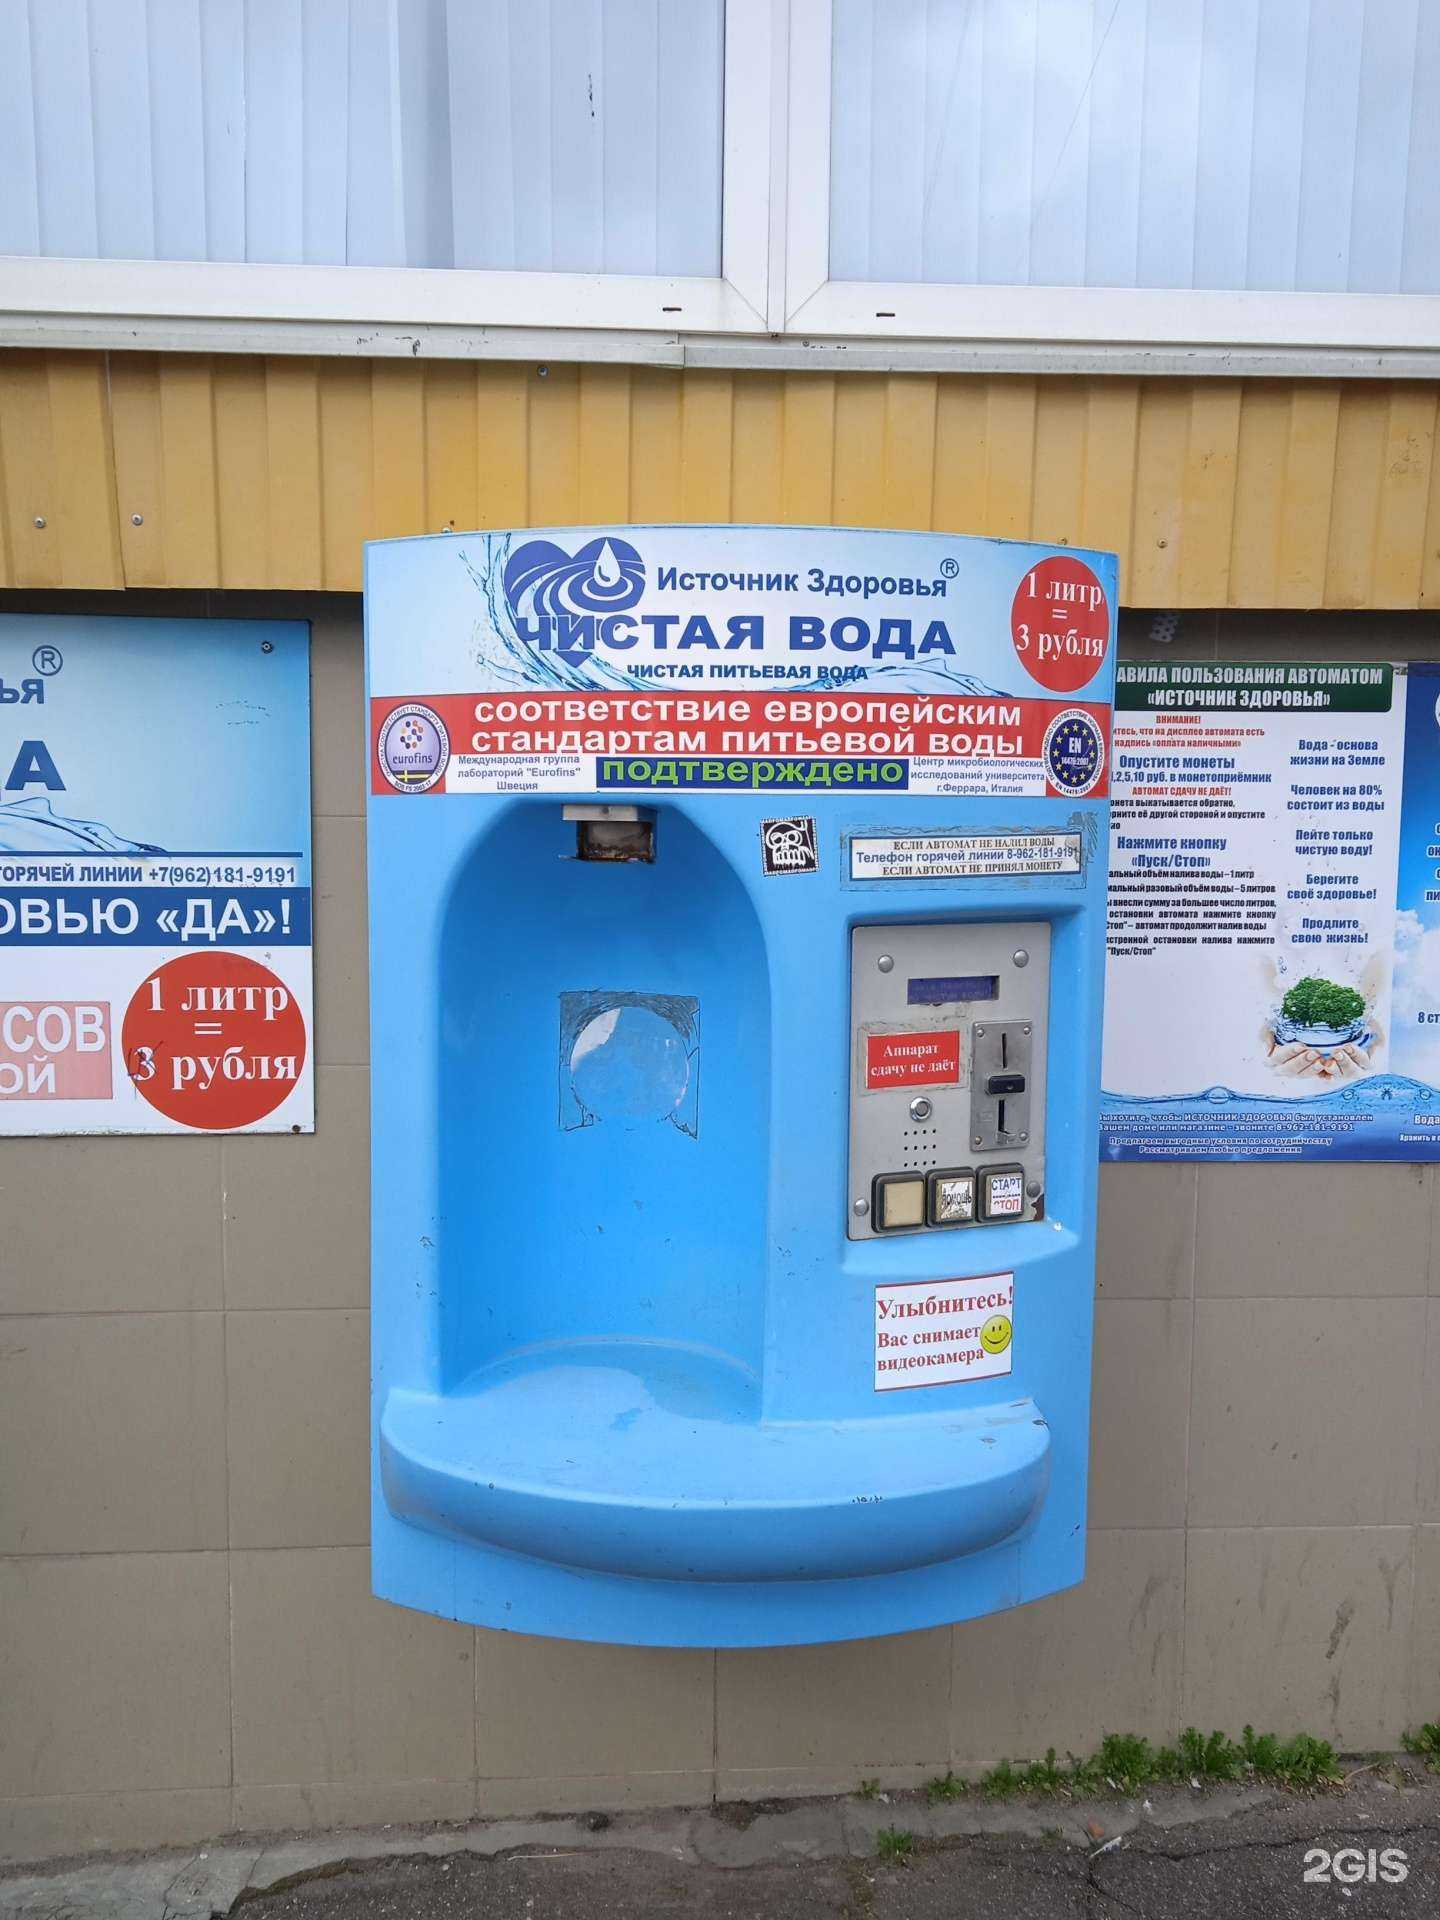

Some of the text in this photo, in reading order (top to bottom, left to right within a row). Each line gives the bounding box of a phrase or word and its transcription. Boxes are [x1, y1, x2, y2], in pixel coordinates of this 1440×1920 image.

[658, 567, 947, 599] Источник Здоровья
[1027, 572, 1103, 612] 1 литр
[515, 615, 956, 660] ЧИСТАЯ ВОДА
[1016, 624, 1104, 660] 3 рубля
[627, 664, 869, 681] ЧИСТАЯ ПИТЬЕВАЯ ВОДА
[1171, 667, 1285, 683] ПОЛЬЗОВАНИЯ
[1287, 668, 1383, 684] АВТОМАТОМ
[1147, 689, 1331, 708] «ИСТОЧНИК ЗДОРОВЬЯ»
[474, 700, 751, 723] соответствие
[764, 695, 1021, 729] европейским
[1156, 715, 1201, 724] ВНИМАНИЕ!
[1139, 728, 1154, 736] что
[1166, 728, 1203, 737] дисплее
[1204, 728, 1245, 736] автомата
[471, 729, 706, 754] стандартам
[722, 726, 914, 753] питьевой
[929, 732, 1023, 758] воды
[1068, 737, 1082, 754] EN
[1114, 740, 1151, 749] надпись
[1298, 739, 1379, 751] Вода основа
[392, 752, 433, 764] eurofins
[458, 755, 580, 766] Международная группа
[913, 757, 1044, 769] Центр микробиологических
[1119, 755, 1235, 769] Опустите монеты
[1290, 755, 1386, 766] жизни на Земле
[458, 767, 581, 779] лабораторий "Eurofins"
[603, 760, 903, 788] подтверждено
[911, 770, 1045, 782] исследований университета
[1147, 771, 1168, 784] руб.
[1178, 771, 1272, 783] монетоприёмник
[496, 781, 538, 792] Швеция
[937, 783, 1024, 794] г.Феррара, Италия
[1132, 786, 1232, 796] АВТОМАТ СДАЧУ ДАЁТ!
[1290, 784, 1383, 796] Человек на 80%
[1135, 799, 1198, 807] выкатывается
[1287, 801, 1385, 812] состоит из воды
[1149, 810, 1266, 820] другой стороной опустите
[1295, 829, 1374, 841] Пейте только
[893, 837, 1055, 851] ЕСЛИ АВТОМАТ НЕ НАЛИЛ ВОДЫ
[1117, 836, 1228, 851] Нажмите кнопку
[857, 846, 1079, 864] Телефон горячей линии 8-962-181-9191
[1295, 844, 1373, 857] чистую воду!
[1131, 854, 1211, 868] «Пуск/Стоп»
[883, 861, 1064, 876] ЕСЛИ АВТОМАТ НЕ ПРИНЯЛ МОНЕТУ
[80, 866, 143, 882] ЛИНИИ
[149, 866, 295, 886] +7(962)181-9191
[1169, 870, 1224, 880] налива воды
[1305, 873, 1359, 886] Берегите
[1146, 883, 1276, 894] разовый объём воды литров
[1287, 888, 1377, 900] своё здоровье!
[1113, 899, 1143, 907] внесли
[1144, 900, 1171, 908] сумму
[1181, 898, 1219, 907] большее
[1219, 899, 1245, 907] число
[1109, 910, 1277, 920] остановки автомата нажмите кнопку
[1135, 922, 1267, 931] автомат продолжит налив воды
[1302, 918, 1359, 930] Продлите
[1153, 936, 1275, 945] остановки налива нажмите
[1291, 932, 1369, 944] свою жизнь!
[147, 977, 288, 1020] 1 литр
[883, 1045, 938, 1058] Аппарат
[134, 1046, 298, 1090] 3 рубля
[871, 1059, 956, 1077] сдачу не даёт
[1151, 1113, 1374, 1122] чтобы ИСТОЧНИК ЗДОРОВЬЯ был установлен
[1132, 1124, 1157, 1132] доме
[1180, 1124, 1226, 1132] магазине
[1276, 1122, 1354, 1131] 8-962-181-9191
[1109, 1136, 1334, 1146] Предлагаем сотрудничеству
[1138, 1146, 1302, 1155] Рассматриваем предложения
[991, 1177, 1022, 1191] СТАРТ
[877, 1285, 1013, 1320] Улыбнитесь!
[878, 1326, 981, 1348] Вас снимает
[877, 1348, 984, 1372] видеокамера
